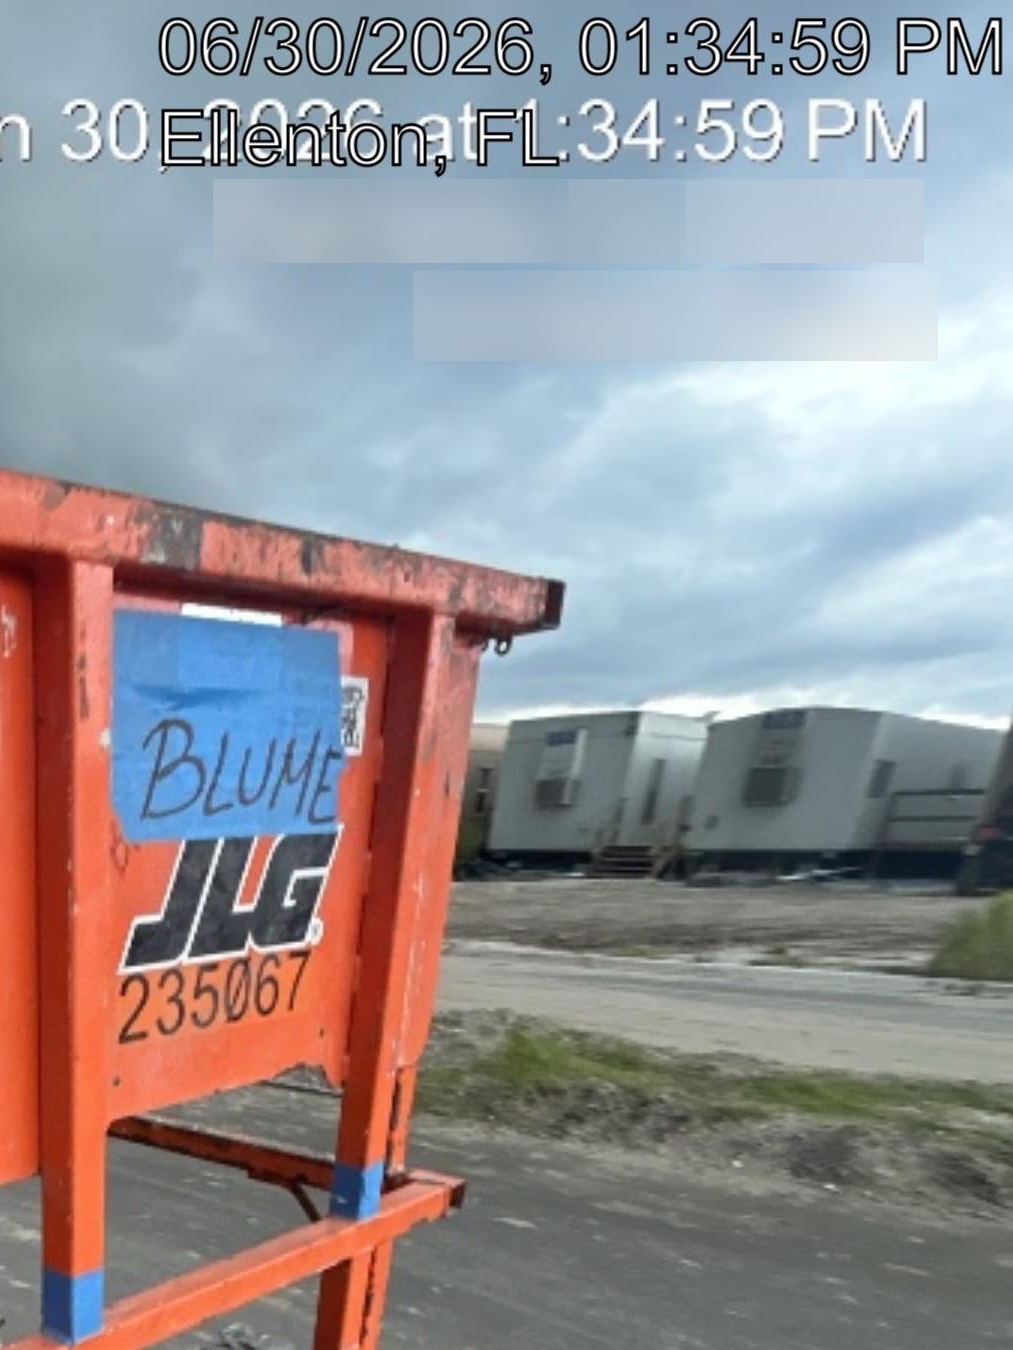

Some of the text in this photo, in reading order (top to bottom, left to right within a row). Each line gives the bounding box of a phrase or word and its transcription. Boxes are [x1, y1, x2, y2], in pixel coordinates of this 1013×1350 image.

[140, 718, 345, 824] BLUME
[118, 824, 344, 976] JLG
[118, 951, 313, 1044] 235067
